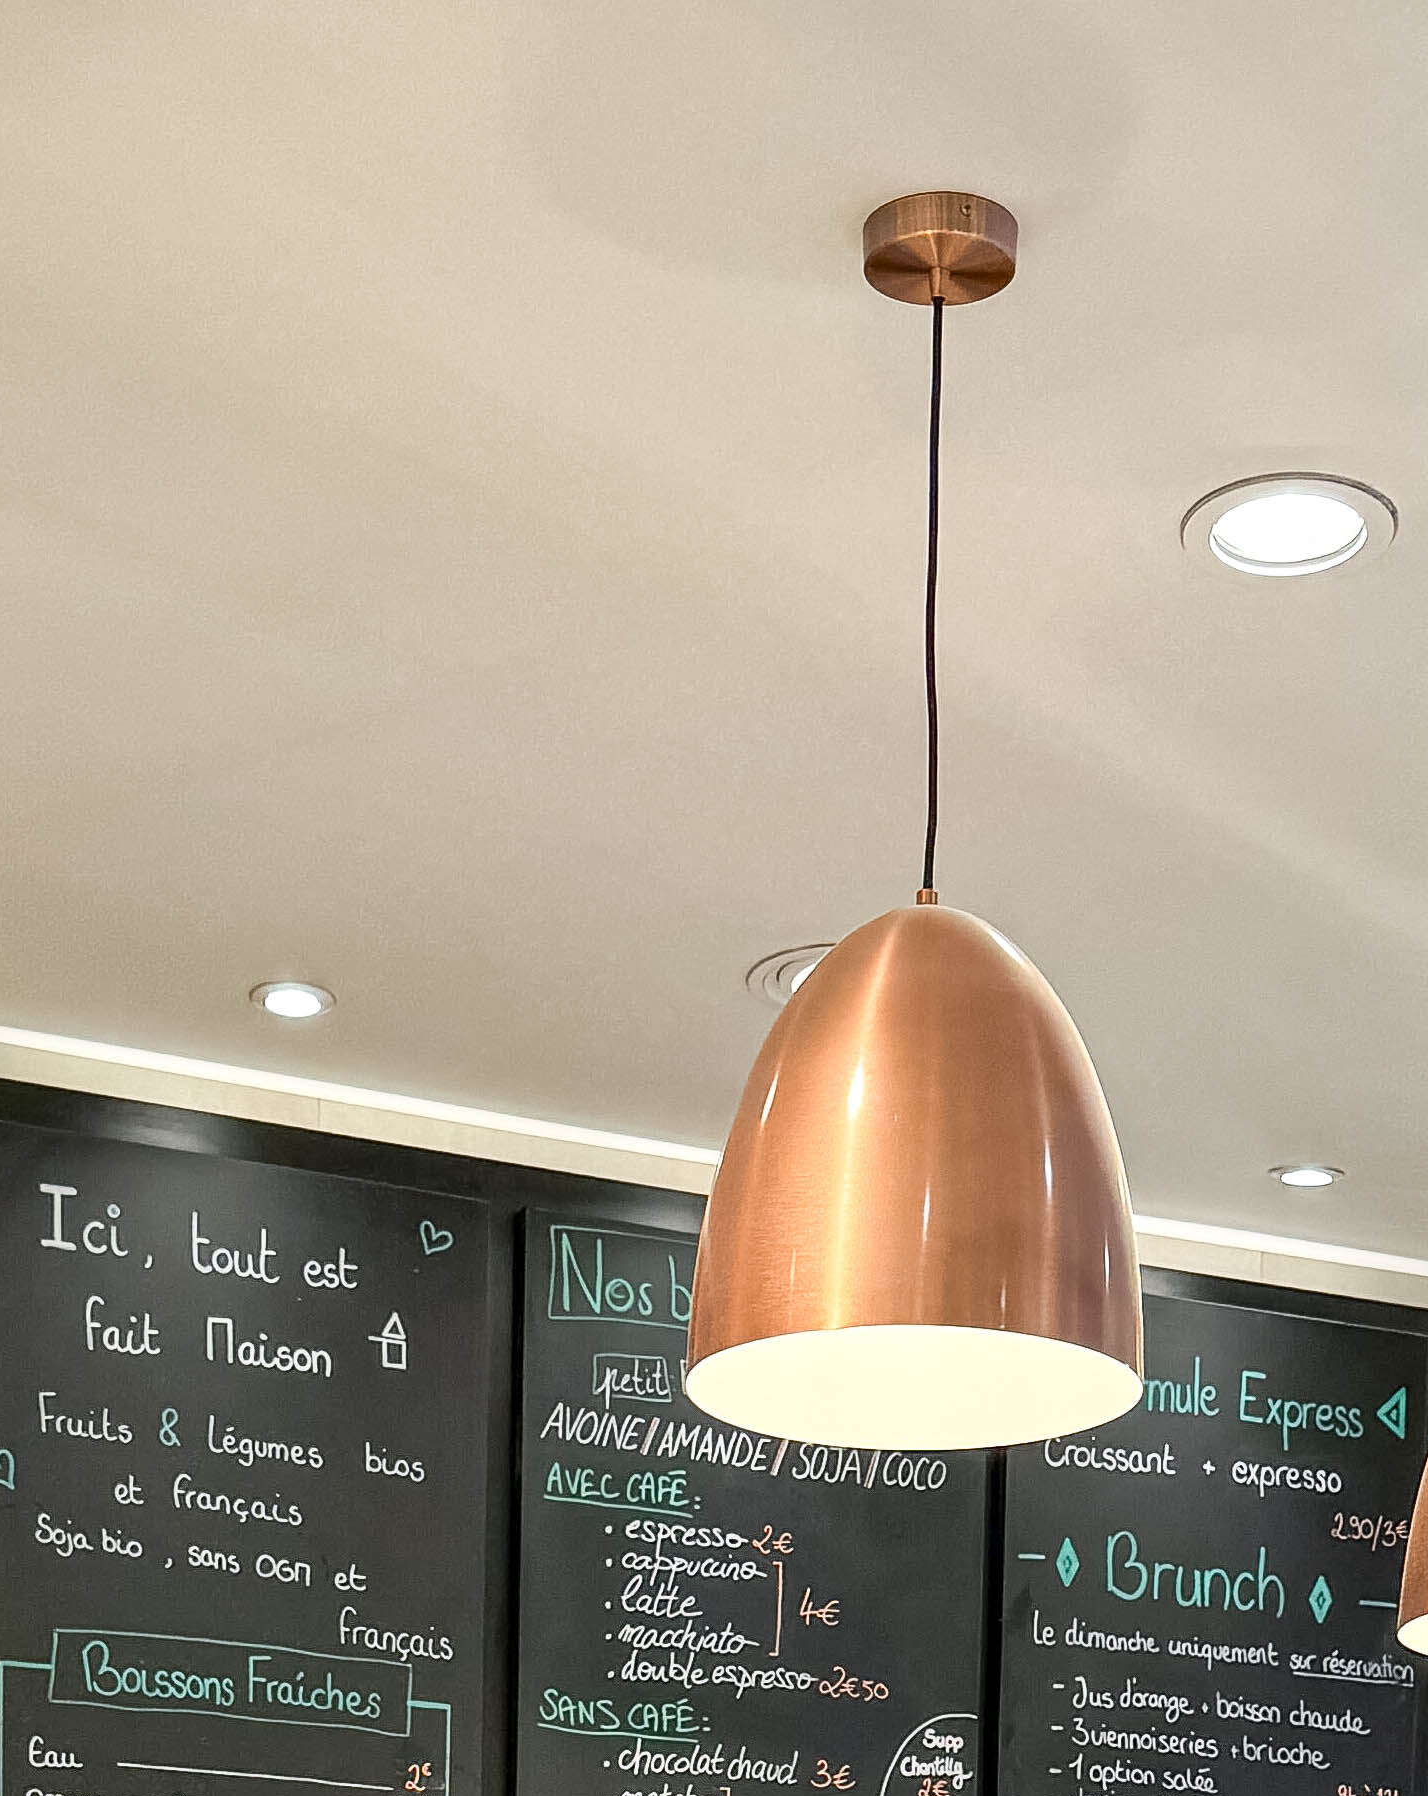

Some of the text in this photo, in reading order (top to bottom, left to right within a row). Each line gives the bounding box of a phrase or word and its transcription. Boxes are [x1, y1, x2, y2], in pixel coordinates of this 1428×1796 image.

[562, 1233, 653, 1315] Nos
[85, 1296, 332, 1377] fait Maison
[599, 1356, 670, 1408] petit
[114, 1474, 303, 1526] et français
[625, 1521, 794, 1559] espresso 2€
[622, 1551, 768, 1588] cappuccino
[1106, 1530, 1285, 1619] Brunch
[618, 1588, 840, 1654] macchiato 4€
[621, 1577, 703, 1618] latte
[338, 1606, 454, 1660] français
[1065, 1618, 1160, 1654] dimanche
[1169, 1638, 1278, 1672] uniquement
[1290, 1654, 1316, 1673] sur
[1322, 1654, 1415, 1682] réservation
[621, 1653, 889, 1700] double espresso 2€50
[1072, 1677, 1371, 1736] Jus d'orange boisson chaude
[29, 1736, 83, 1769] Eau
[618, 1738, 855, 1790] chocolat chaud 3€
